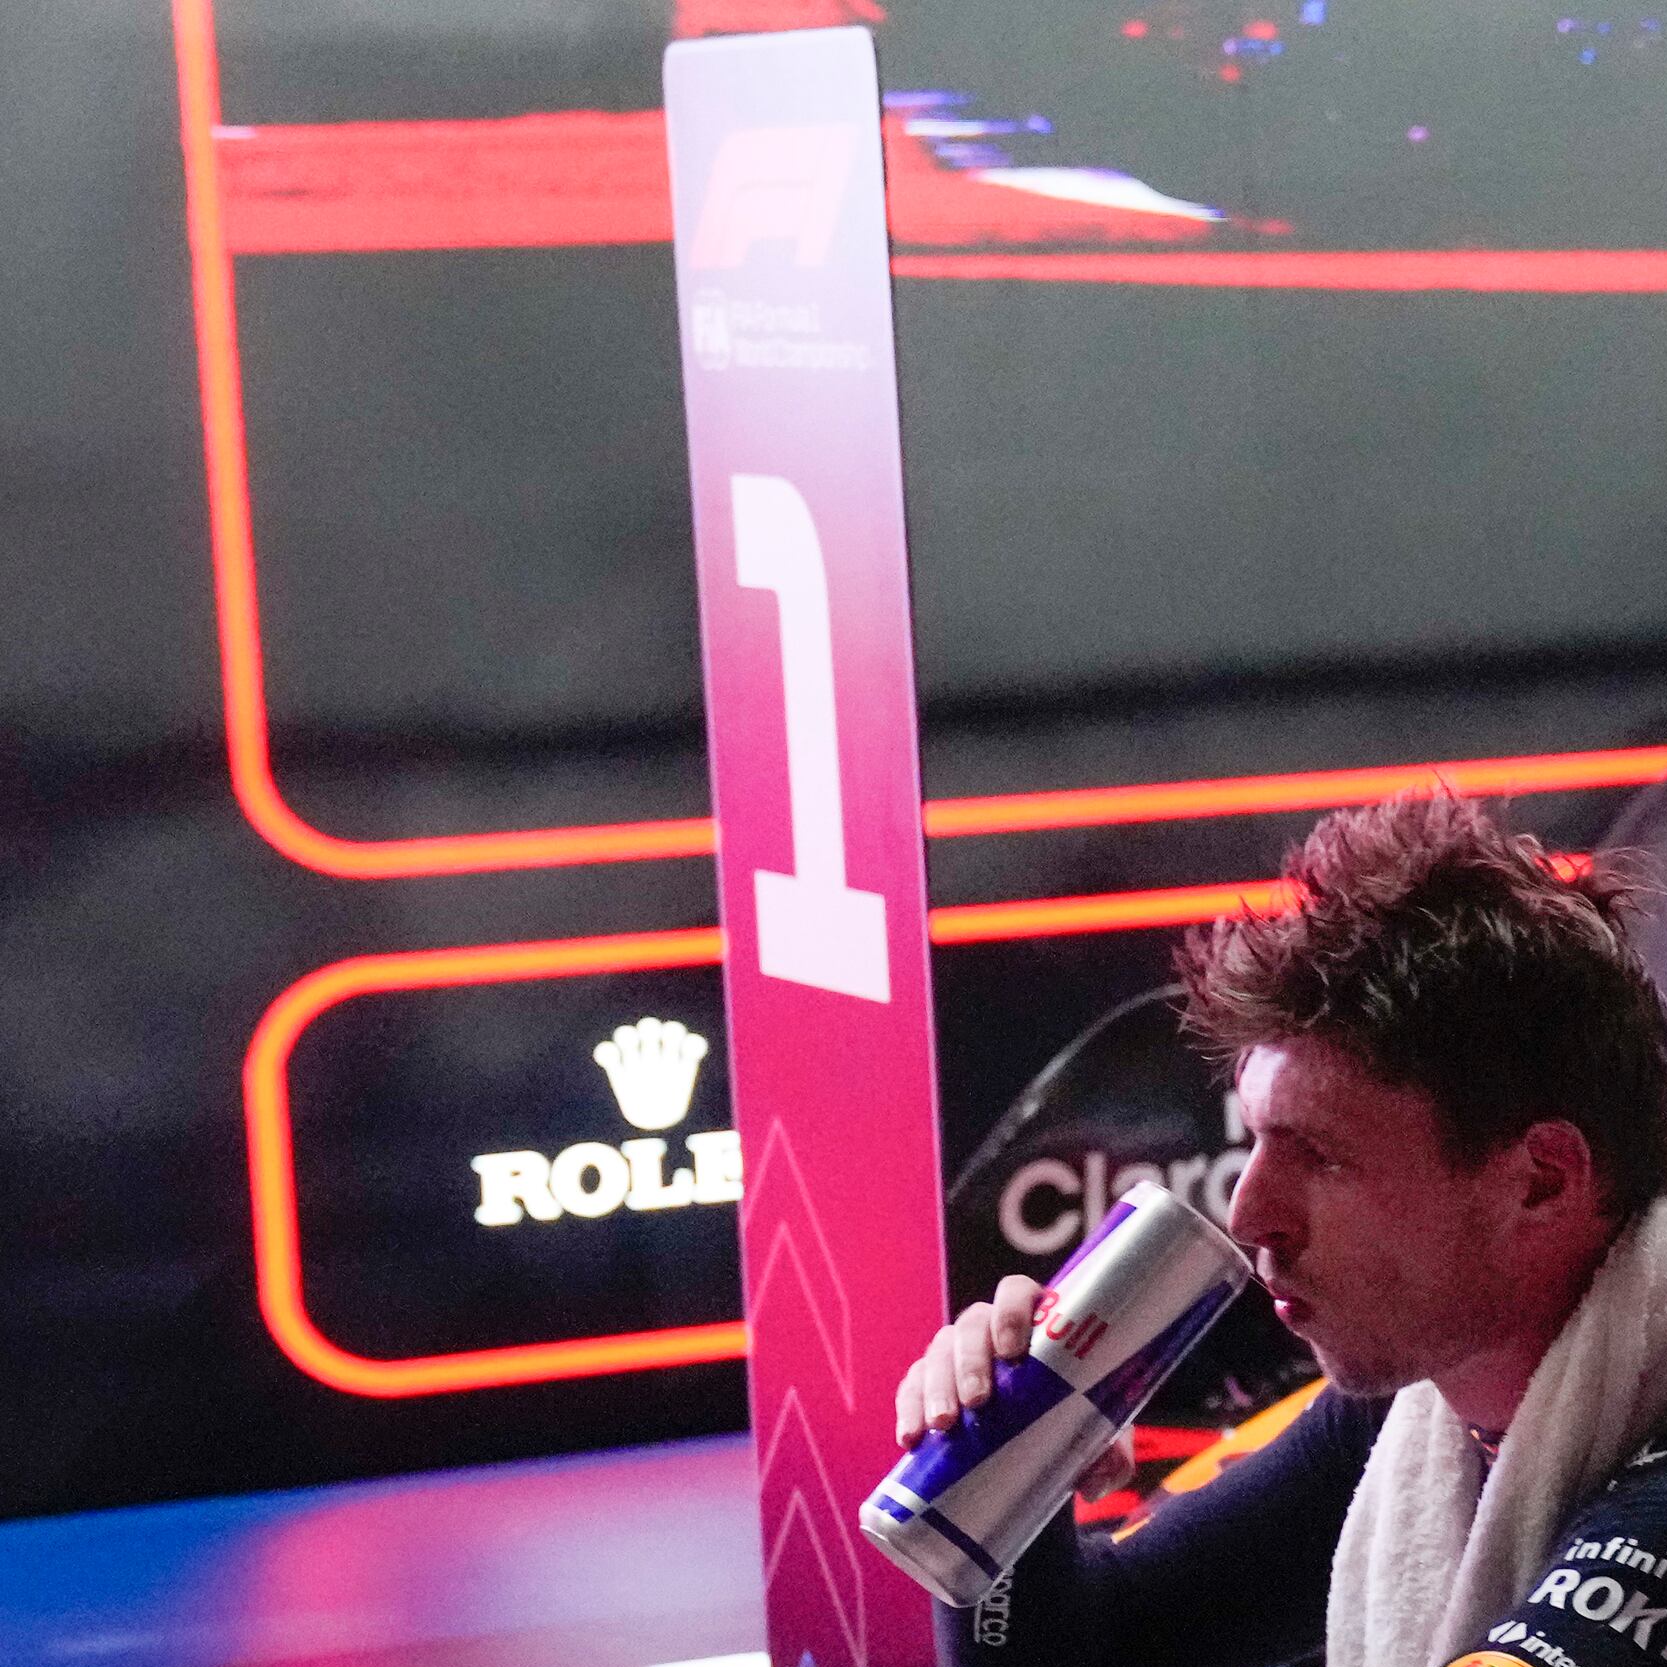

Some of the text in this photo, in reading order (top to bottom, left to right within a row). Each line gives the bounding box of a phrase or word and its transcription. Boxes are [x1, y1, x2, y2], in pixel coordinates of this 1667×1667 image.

[730, 473, 891, 1003] 1
[471, 1130, 744, 1226] ROLE
[1032, 1287, 1109, 1359] Bull
